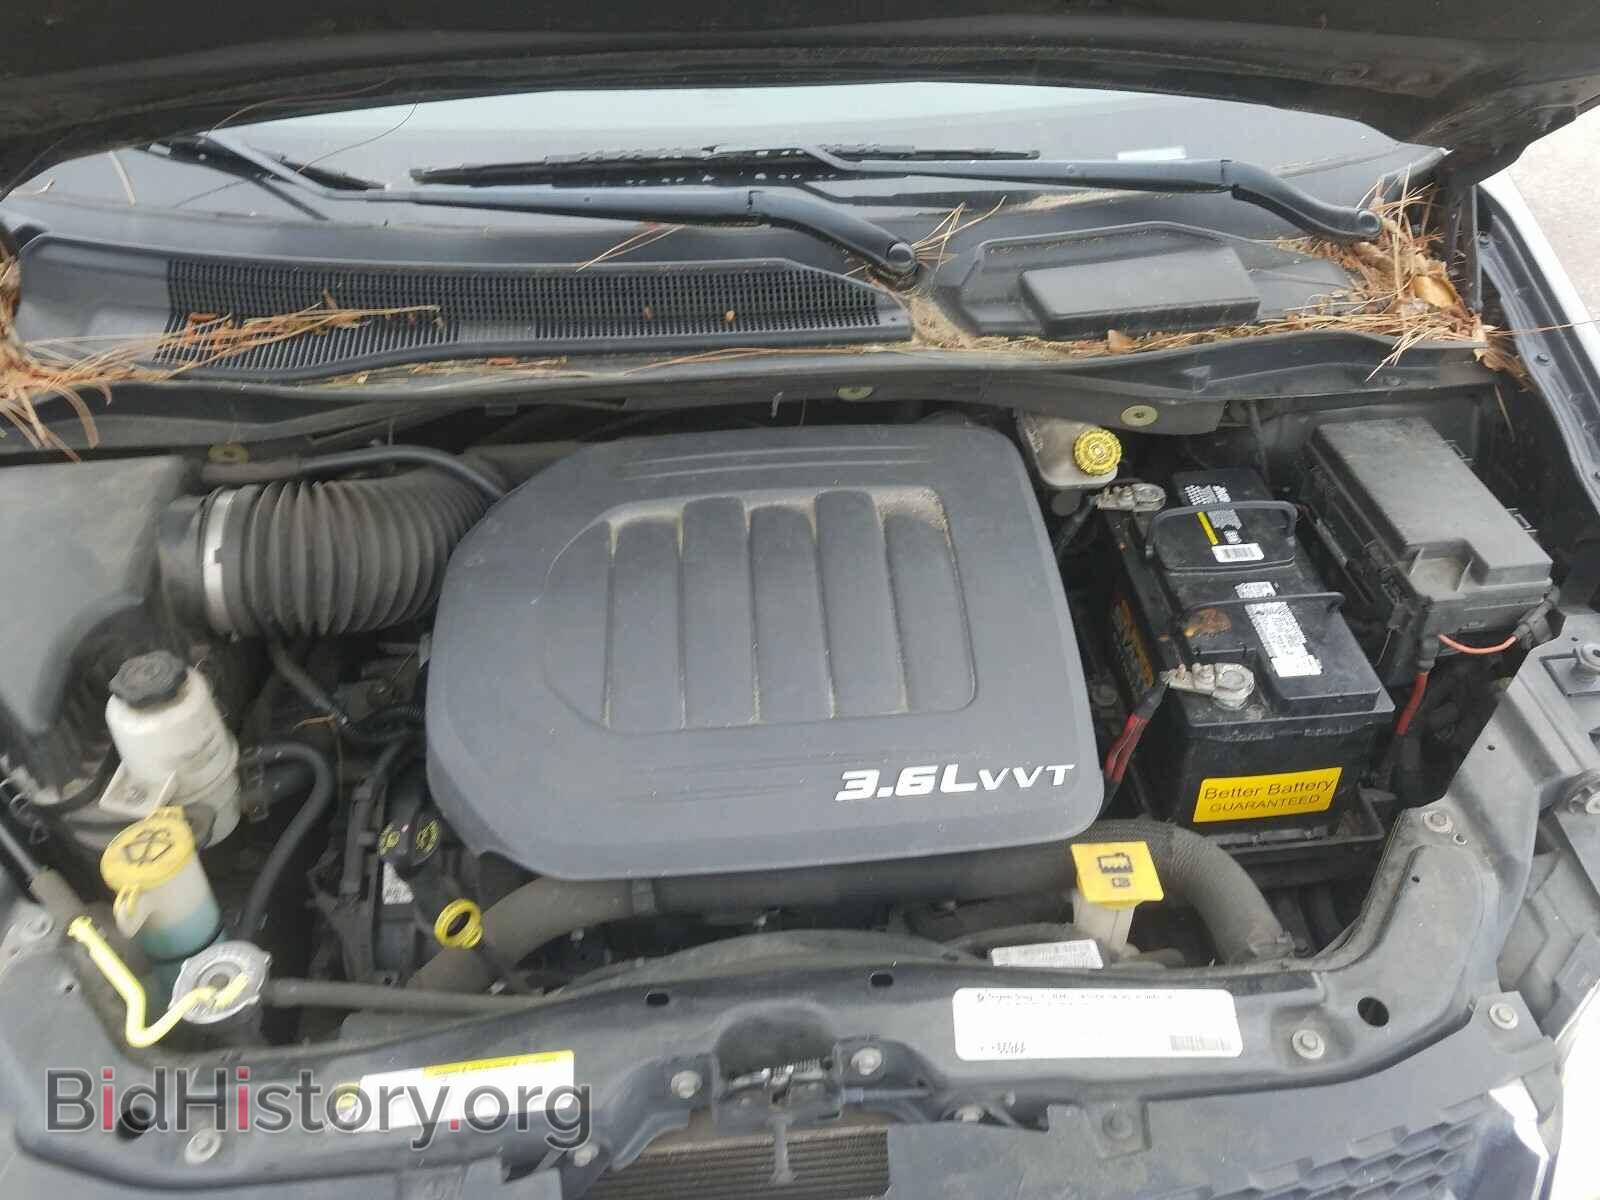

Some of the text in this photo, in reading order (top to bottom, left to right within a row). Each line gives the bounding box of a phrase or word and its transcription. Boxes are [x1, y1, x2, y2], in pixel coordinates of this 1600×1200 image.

[835, 763, 977, 801] 3.6L
[1204, 778, 1335, 800] Better Battery
[1209, 794, 1320, 812] GUARANTEED
